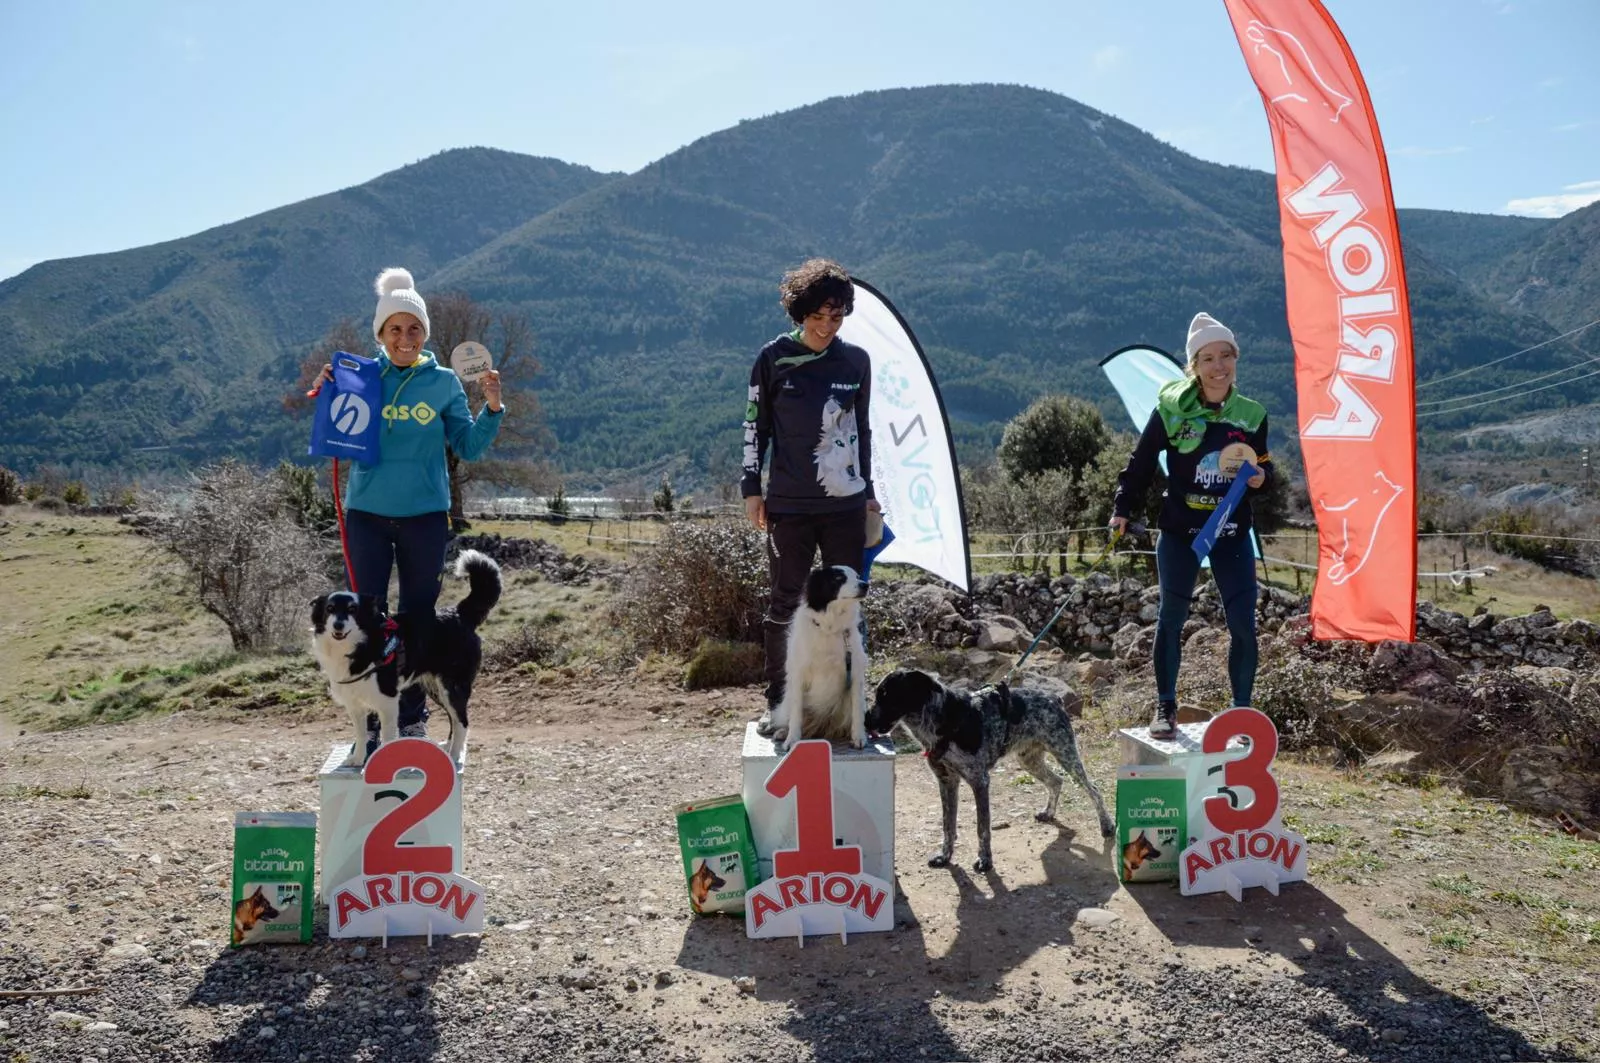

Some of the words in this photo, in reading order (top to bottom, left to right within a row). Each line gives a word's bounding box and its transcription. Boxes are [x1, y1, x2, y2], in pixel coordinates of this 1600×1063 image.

[1202, 708, 1279, 835] 3
[363, 738, 455, 876] 2
[765, 741, 861, 879] 1
[243, 859, 304, 872] titanium
[260, 848, 290, 859] ARION
[1185, 832, 1301, 886] ARION
[336, 874, 478, 929] ARION
[751, 875, 887, 930] ARION
